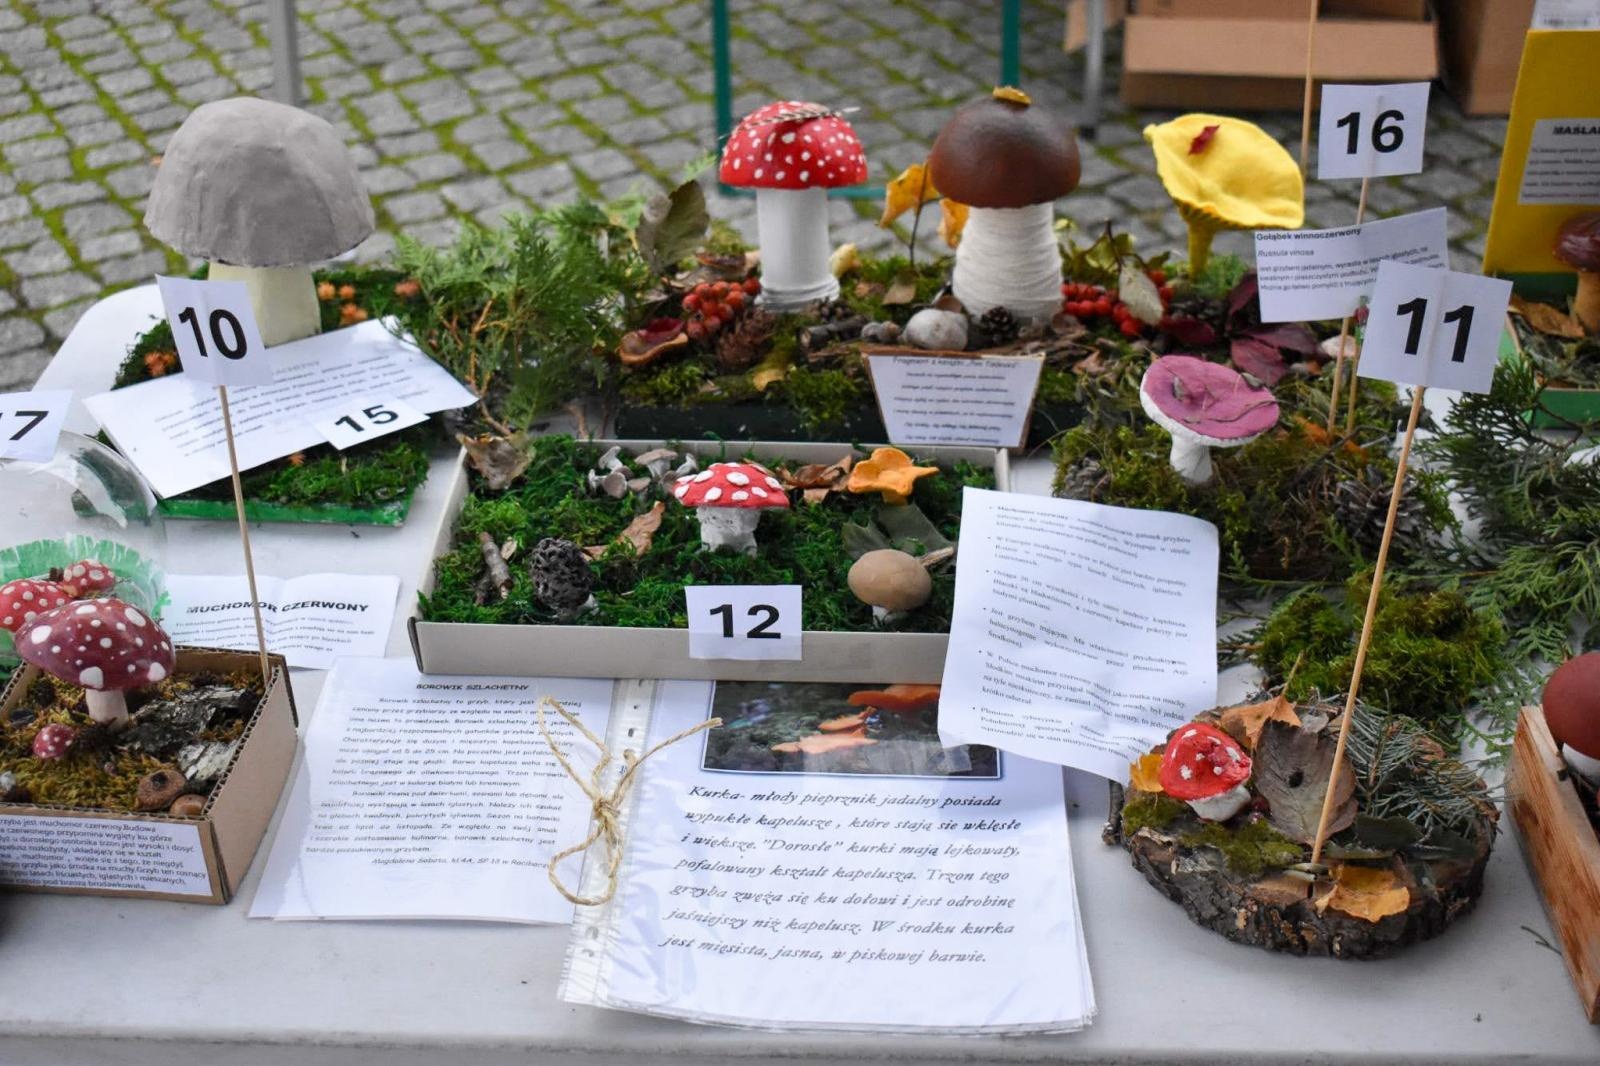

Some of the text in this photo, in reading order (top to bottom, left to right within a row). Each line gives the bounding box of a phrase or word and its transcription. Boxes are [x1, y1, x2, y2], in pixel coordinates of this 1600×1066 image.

[1337, 109, 1405, 154] 16
[1257, 227, 1362, 241] Gołąbek winnoczerwony
[178, 306, 248, 360] 10
[1396, 297, 1475, 363] 11
[0, 411, 49, 441] 7
[334, 404, 400, 433] 15
[186, 601, 369, 613] MUCHOMOR CZERWONY
[709, 604, 781, 639] 12
[689, 785, 1001, 809] Kurka- młody pieprznik jadalny posiada
[685, 811, 751, 827] wypukłe
[755, 815, 832, 830] kapelusze
[849, 817, 890, 830] które
[895, 819, 935, 833] stają
[940, 821, 958, 831] sie
[963, 818, 1021, 833] wklęsłe
[681, 833, 689, 843] i
[693, 834, 757, 851] większe.
[847, 841, 896, 855] kurki
[900, 846, 938, 858] mają
[944, 843, 1020, 858] lejkowaty,
[674, 858, 765, 878] pofalowany
[832, 867, 916, 883] kapelusza.
[927, 869, 975, 883] Trzon
[980, 871, 1010, 884] tego
[670, 883, 1016, 910] grzyba zwęża się ku dołowi i jest odrobinę
[665, 907, 1015, 935] jaśniejszy niż kapelusz. W środku kurka
[659, 934, 986, 965] jest mięsista, jasna, w piskowej barwie.
